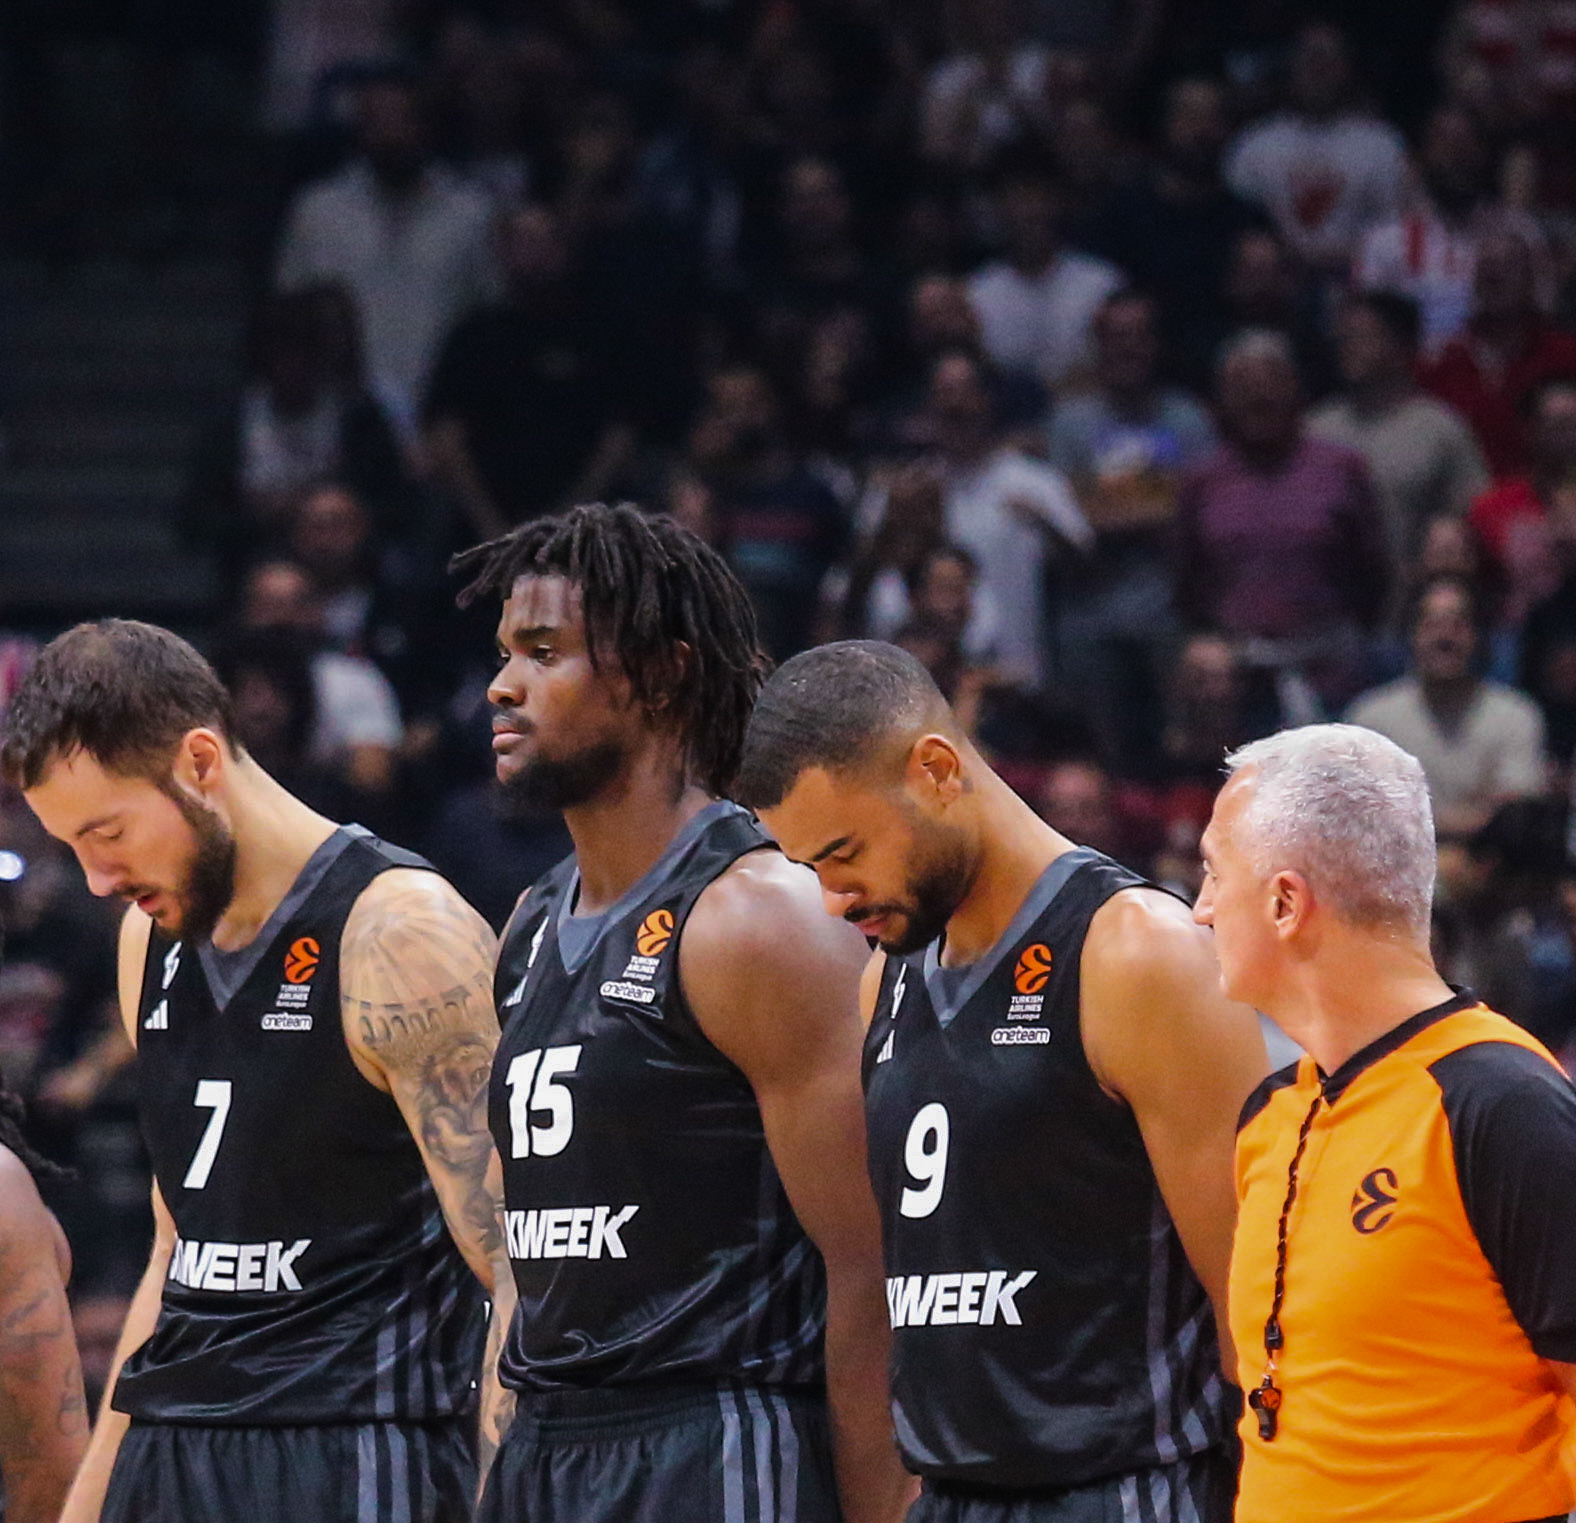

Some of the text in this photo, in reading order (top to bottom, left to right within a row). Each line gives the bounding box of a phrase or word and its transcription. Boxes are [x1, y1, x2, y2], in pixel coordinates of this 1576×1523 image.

[601, 982, 655, 1003] oneteam
[1011, 995, 1044, 1003] TURKISH
[1009, 1004, 1042, 1012] AIRLINES
[262, 1012, 313, 1030] oneteam
[992, 1026, 1050, 1044] oneteam
[505, 1044, 583, 1159] 15
[182, 1079, 232, 1189] 7
[899, 1102, 950, 1218] 9
